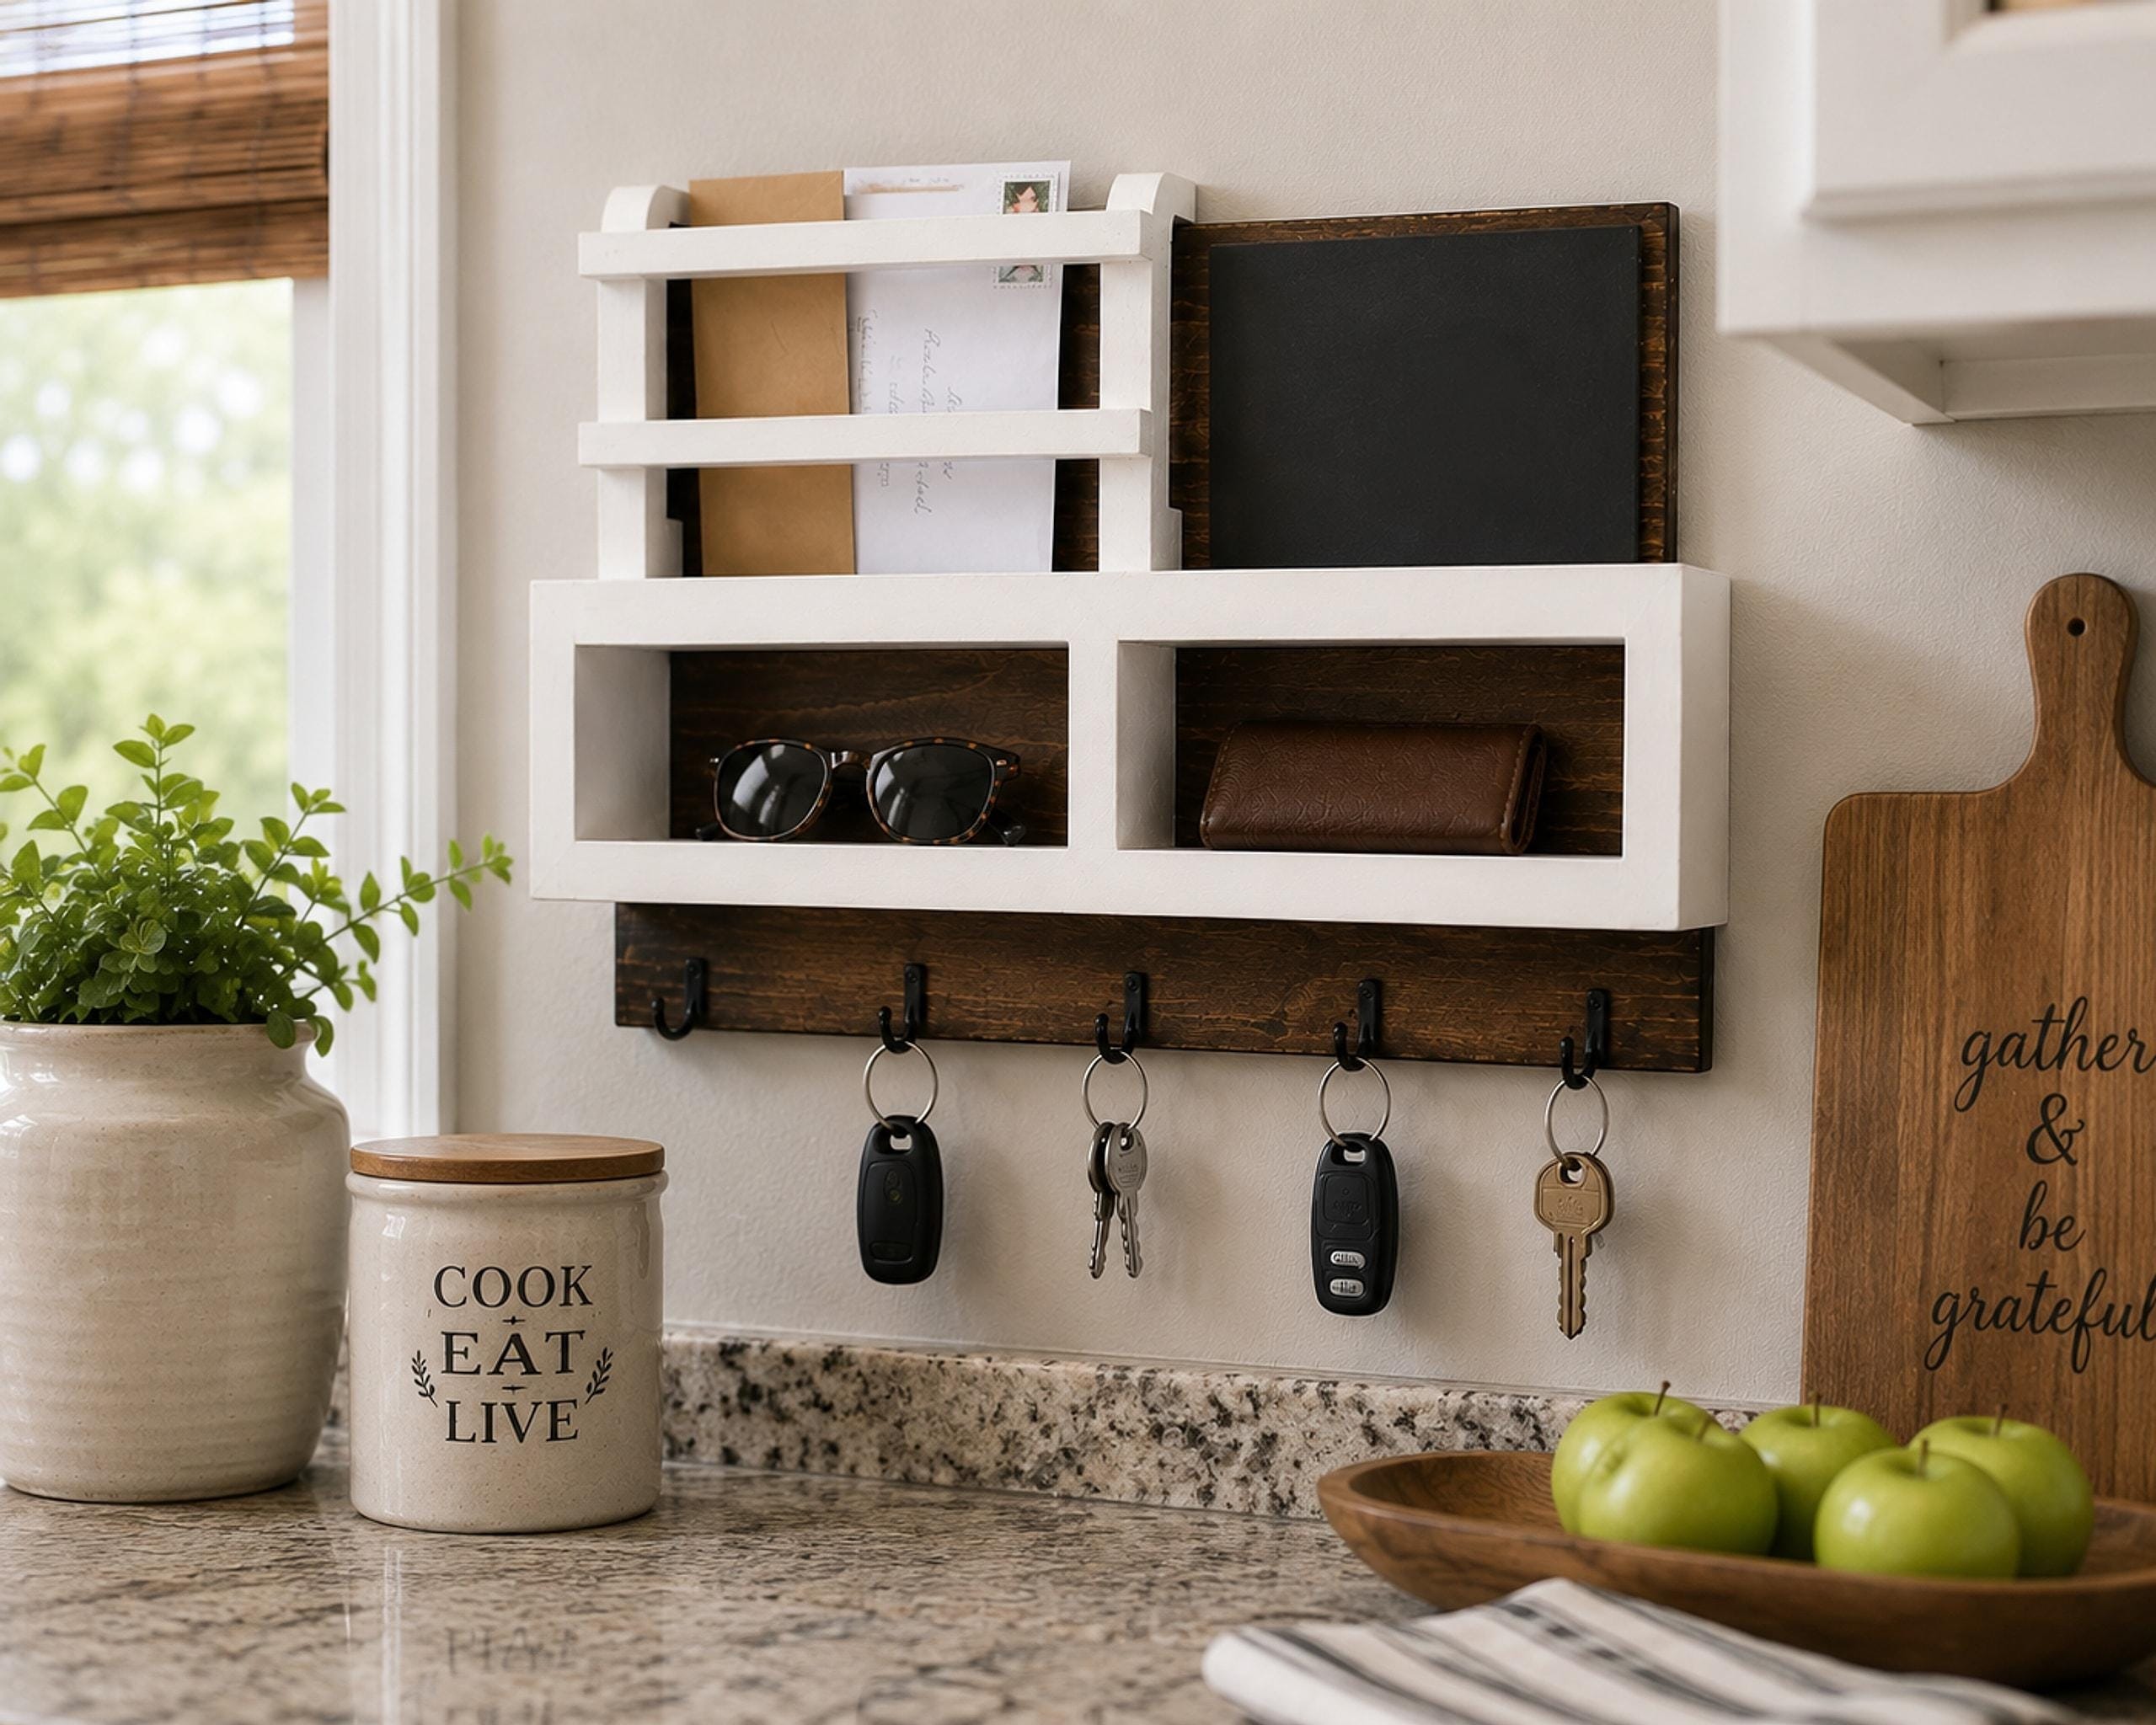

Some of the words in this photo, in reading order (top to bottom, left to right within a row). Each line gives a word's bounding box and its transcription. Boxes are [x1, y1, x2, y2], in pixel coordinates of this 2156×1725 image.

[1954, 996, 2156, 1113] gather
[2025, 1093, 2085, 1166] &
[2019, 1180, 2085, 1252] be
[433, 1265, 593, 1307] COOK
[1923, 1268, 2156, 1374] grateful
[441, 1330, 586, 1375] EAT
[445, 1399, 580, 1443] LIVE
